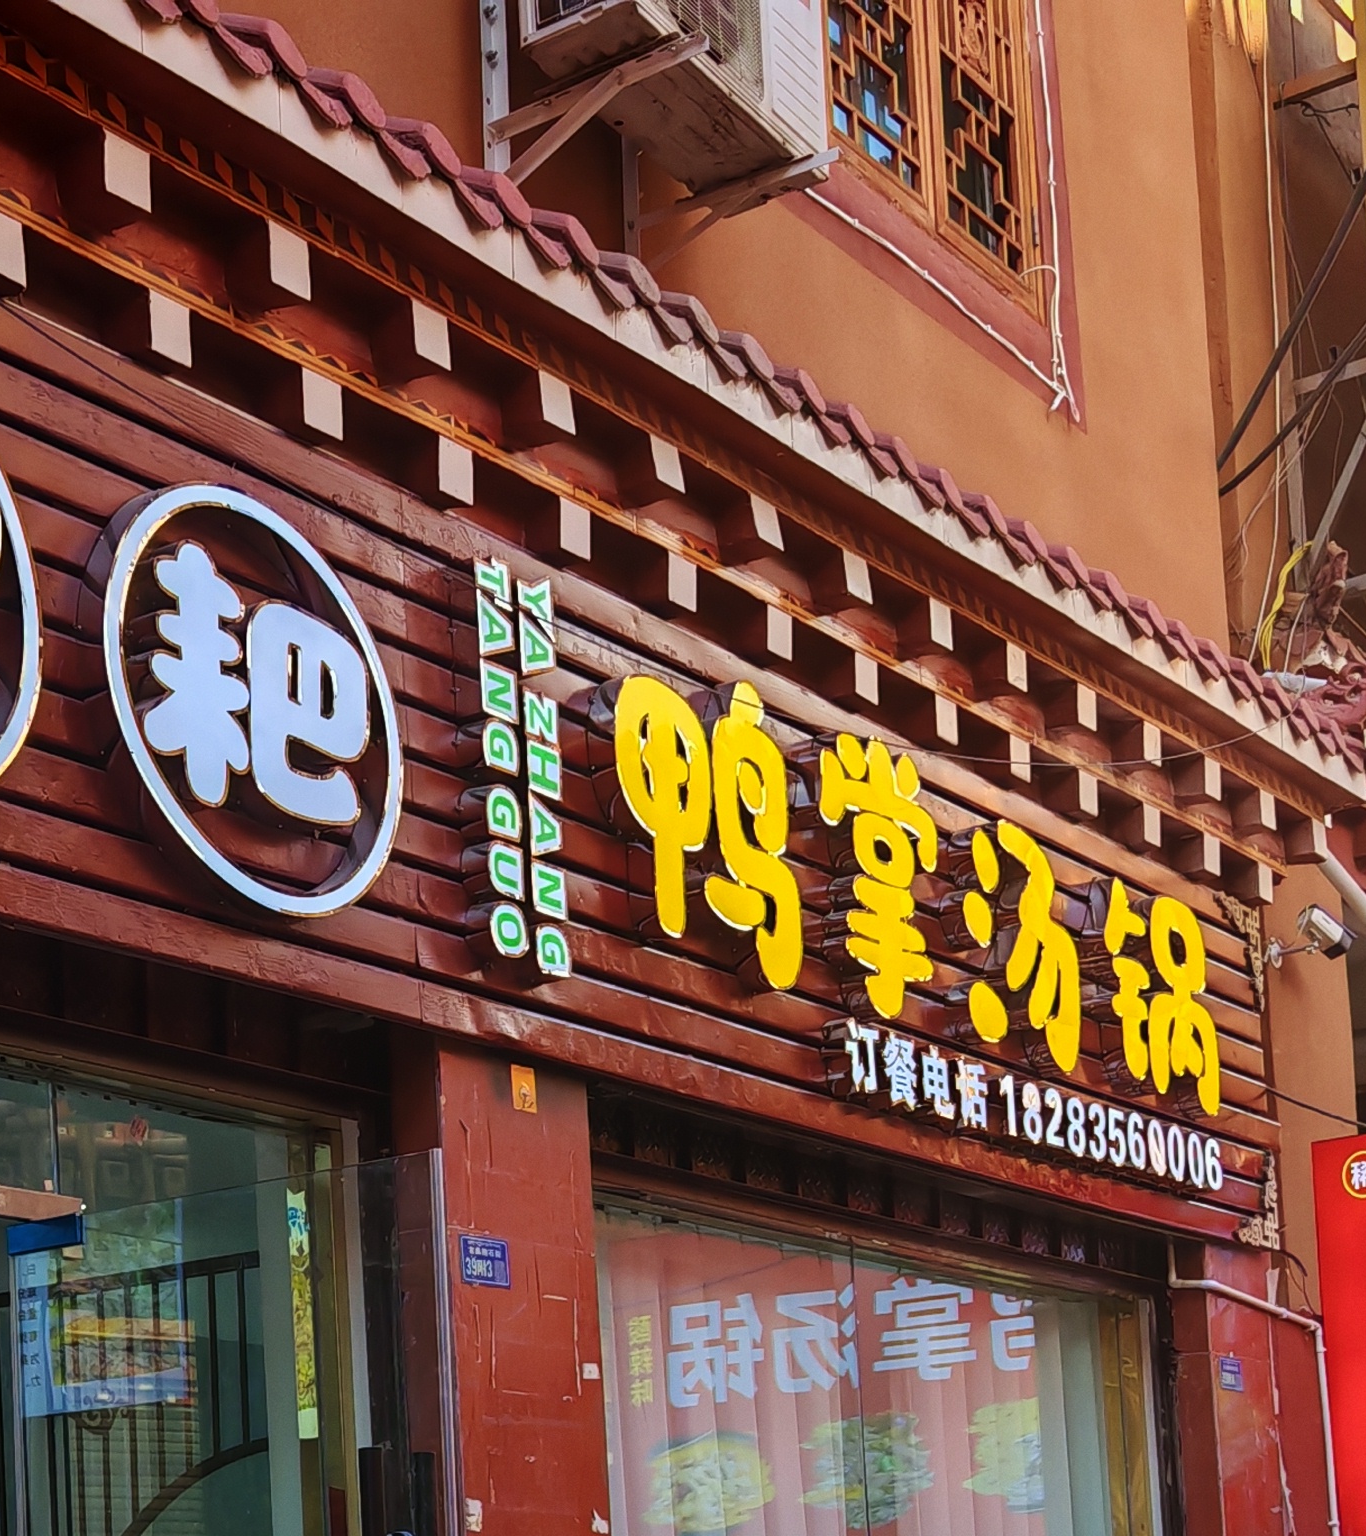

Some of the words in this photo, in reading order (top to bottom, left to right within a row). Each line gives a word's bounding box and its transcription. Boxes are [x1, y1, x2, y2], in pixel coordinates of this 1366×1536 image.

[474, 556, 521, 778] TANG
[517, 575, 557, 676] YA
[485, 783, 530, 958] GUO
[523, 687, 572, 978] ZHANG
[614, 674, 1220, 1118] 鸭掌汤锅
[844, 1016, 989, 1132] 订餐电话
[999, 1073, 1224, 1191] 18283560006
